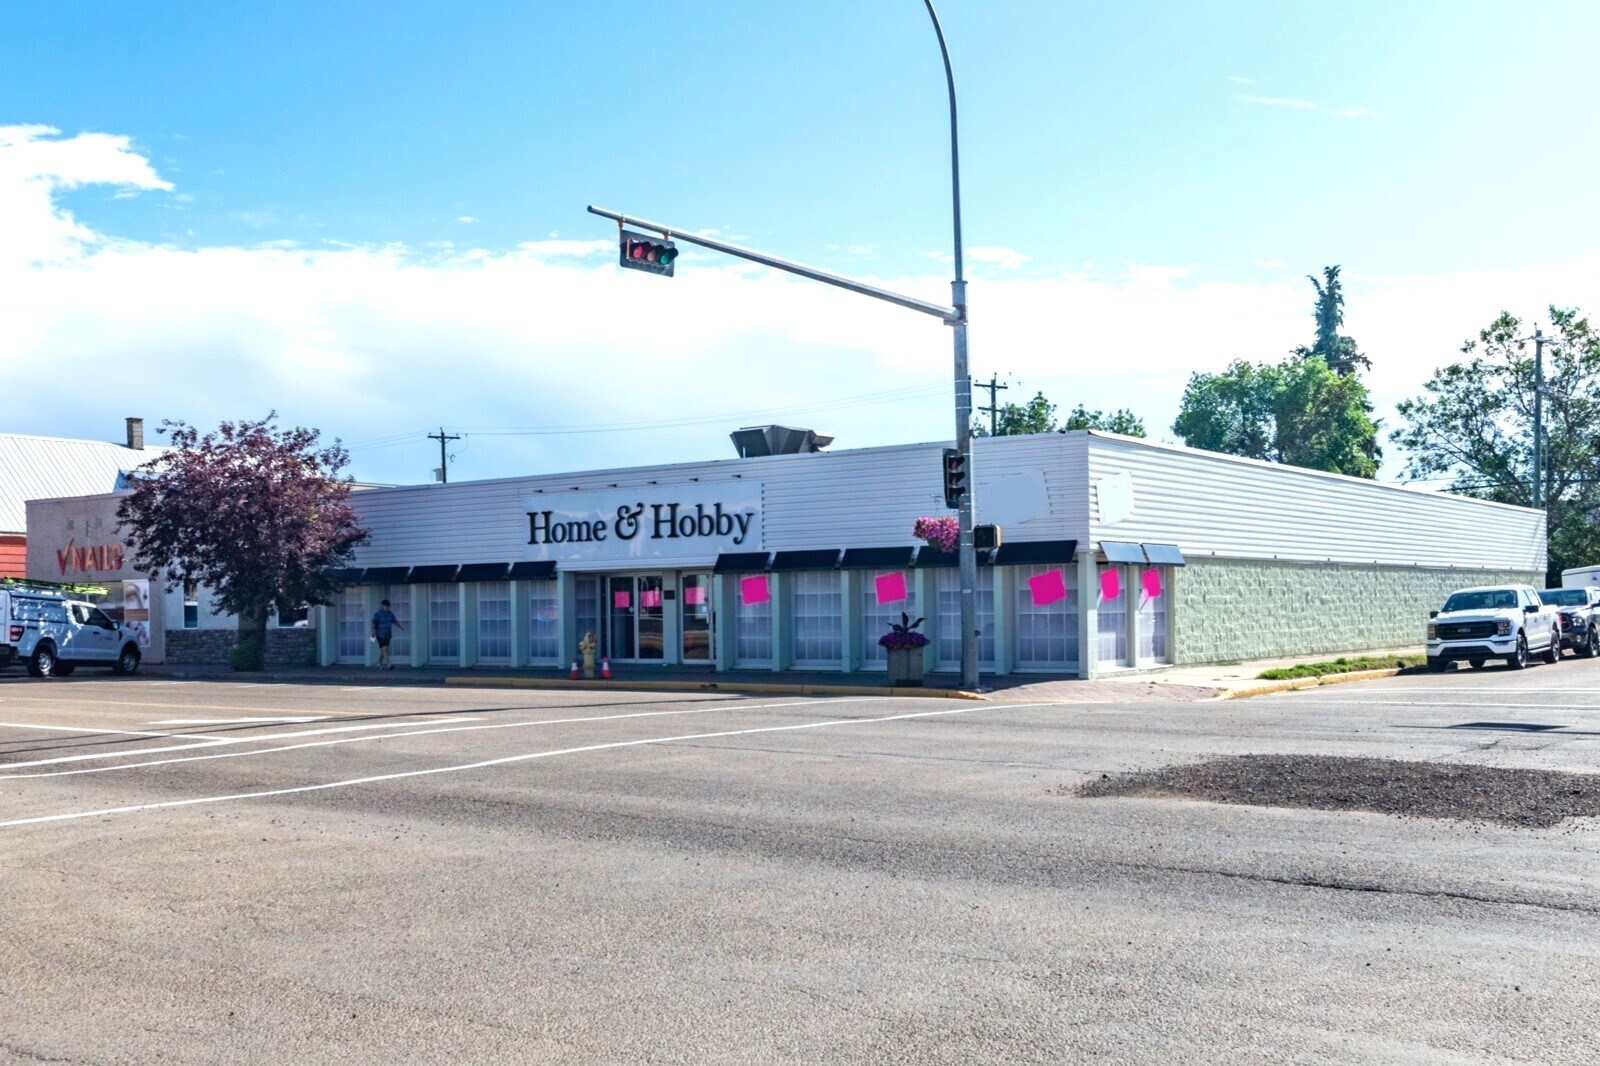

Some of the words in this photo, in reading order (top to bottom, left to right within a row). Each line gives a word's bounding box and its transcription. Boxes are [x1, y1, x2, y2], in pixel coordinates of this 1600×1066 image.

[527, 511, 607, 544] Home
[615, 502, 644, 540] &
[650, 502, 754, 545] Hobby
